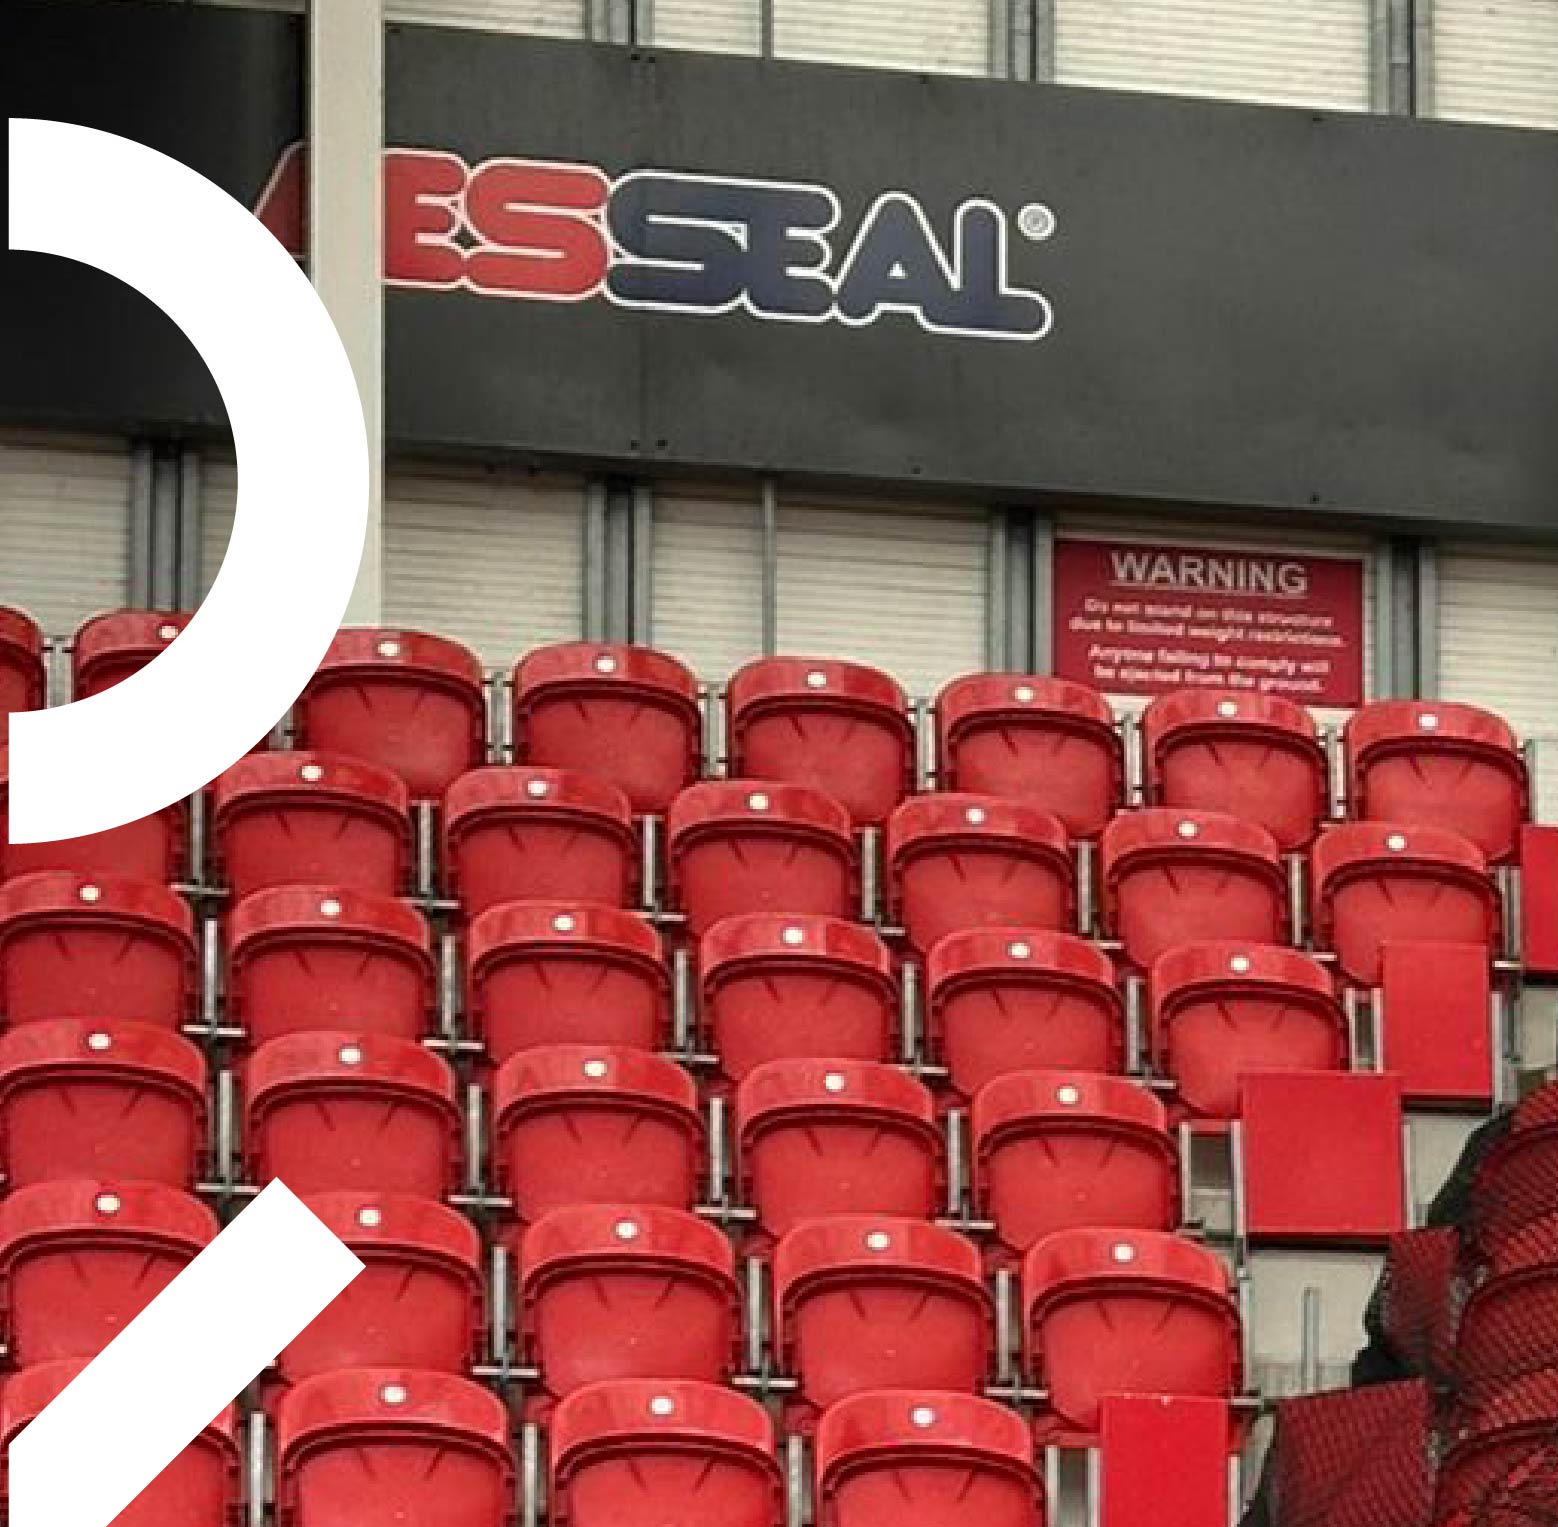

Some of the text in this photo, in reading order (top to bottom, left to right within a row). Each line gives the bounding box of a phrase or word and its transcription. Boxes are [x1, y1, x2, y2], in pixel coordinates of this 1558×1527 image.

[1110, 551, 1308, 593] WARNING
[1088, 643, 1153, 664] Anyone
[1236, 654, 1296, 676] comply
[1300, 659, 1330, 673] will
[1093, 664, 1116, 678] be
[1183, 669, 1224, 684] from
[1227, 671, 1255, 687] the
